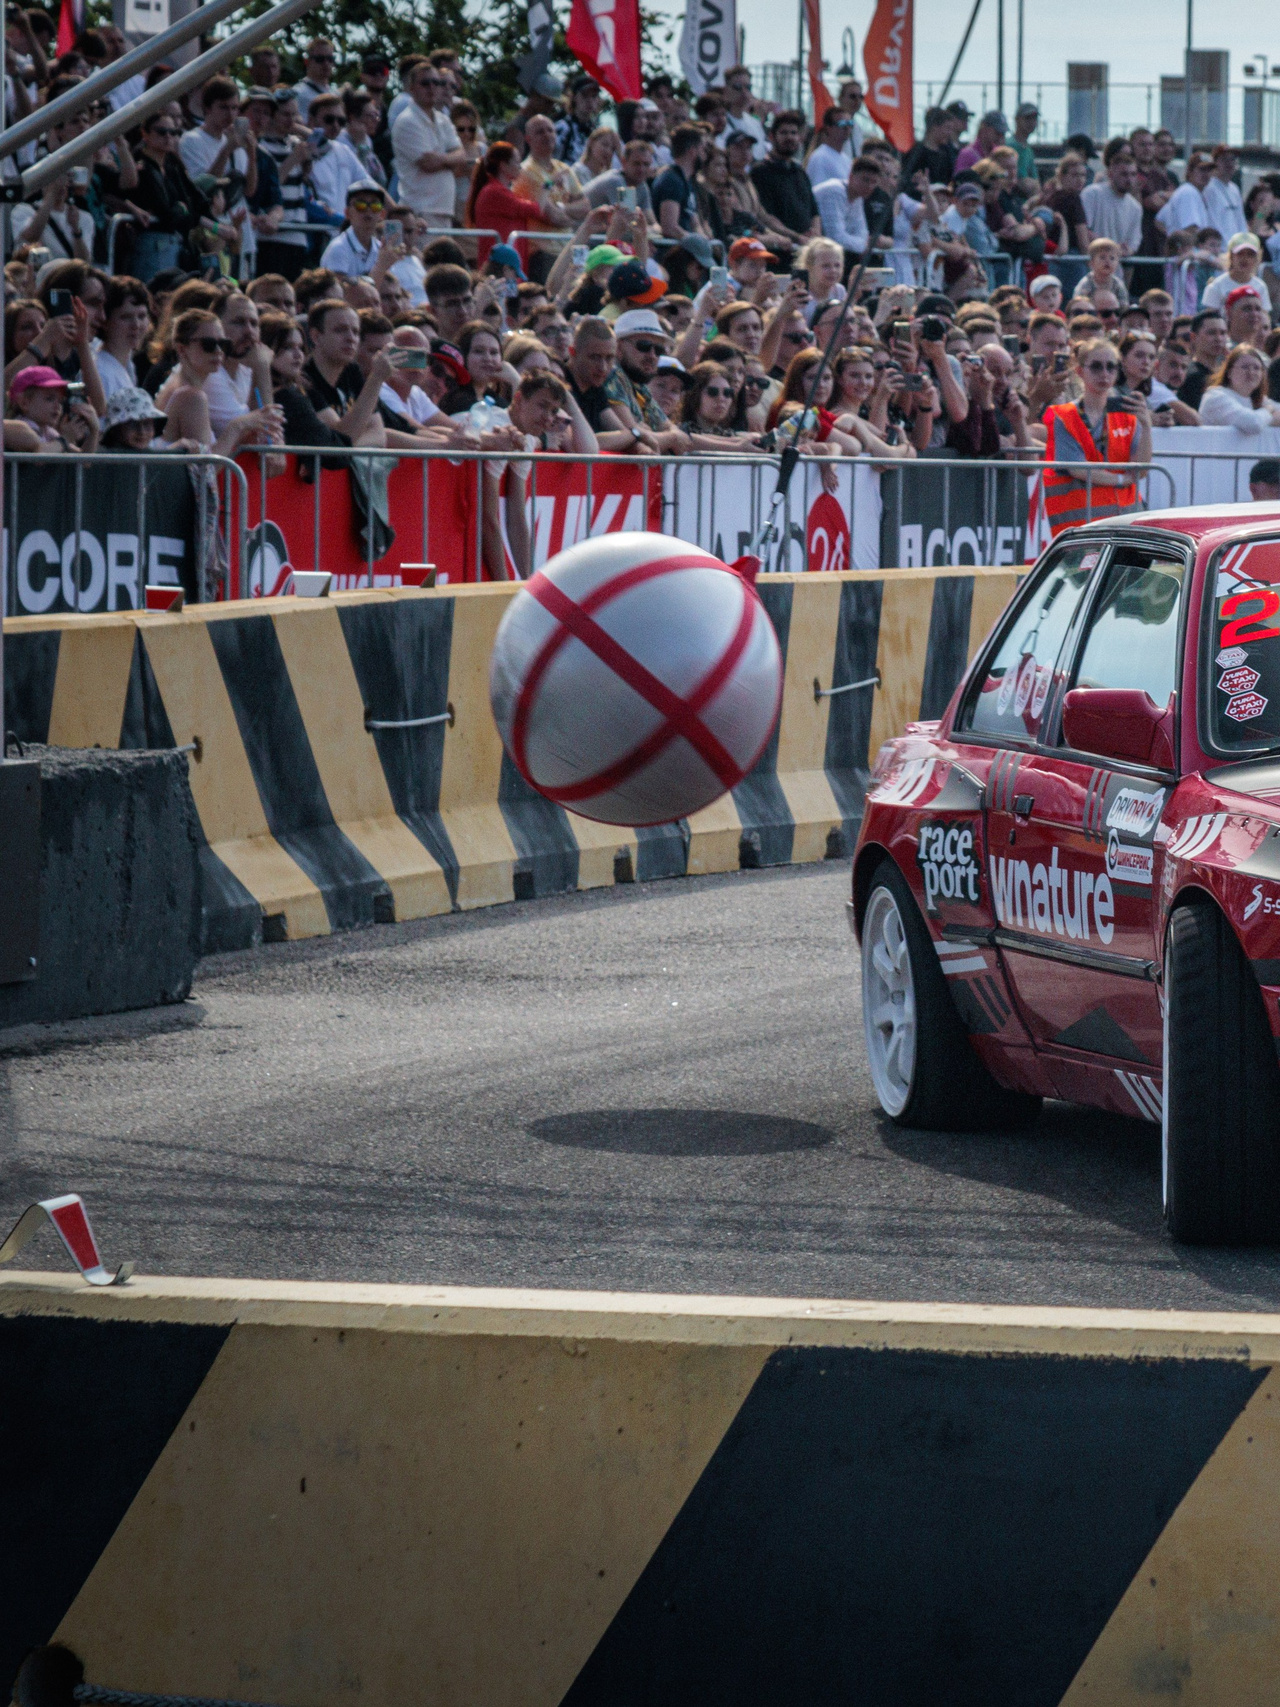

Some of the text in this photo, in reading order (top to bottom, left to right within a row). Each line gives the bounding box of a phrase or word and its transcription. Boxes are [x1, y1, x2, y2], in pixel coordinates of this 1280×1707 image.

[1221, 674, 1256, 688] G-TAXI
[1225, 670, 1249, 680] YUKA
[1229, 699, 1262, 714] G-TAXI
[1232, 695, 1255, 706] YUKA
[918, 824, 973, 866] race
[922, 859, 979, 910] port
